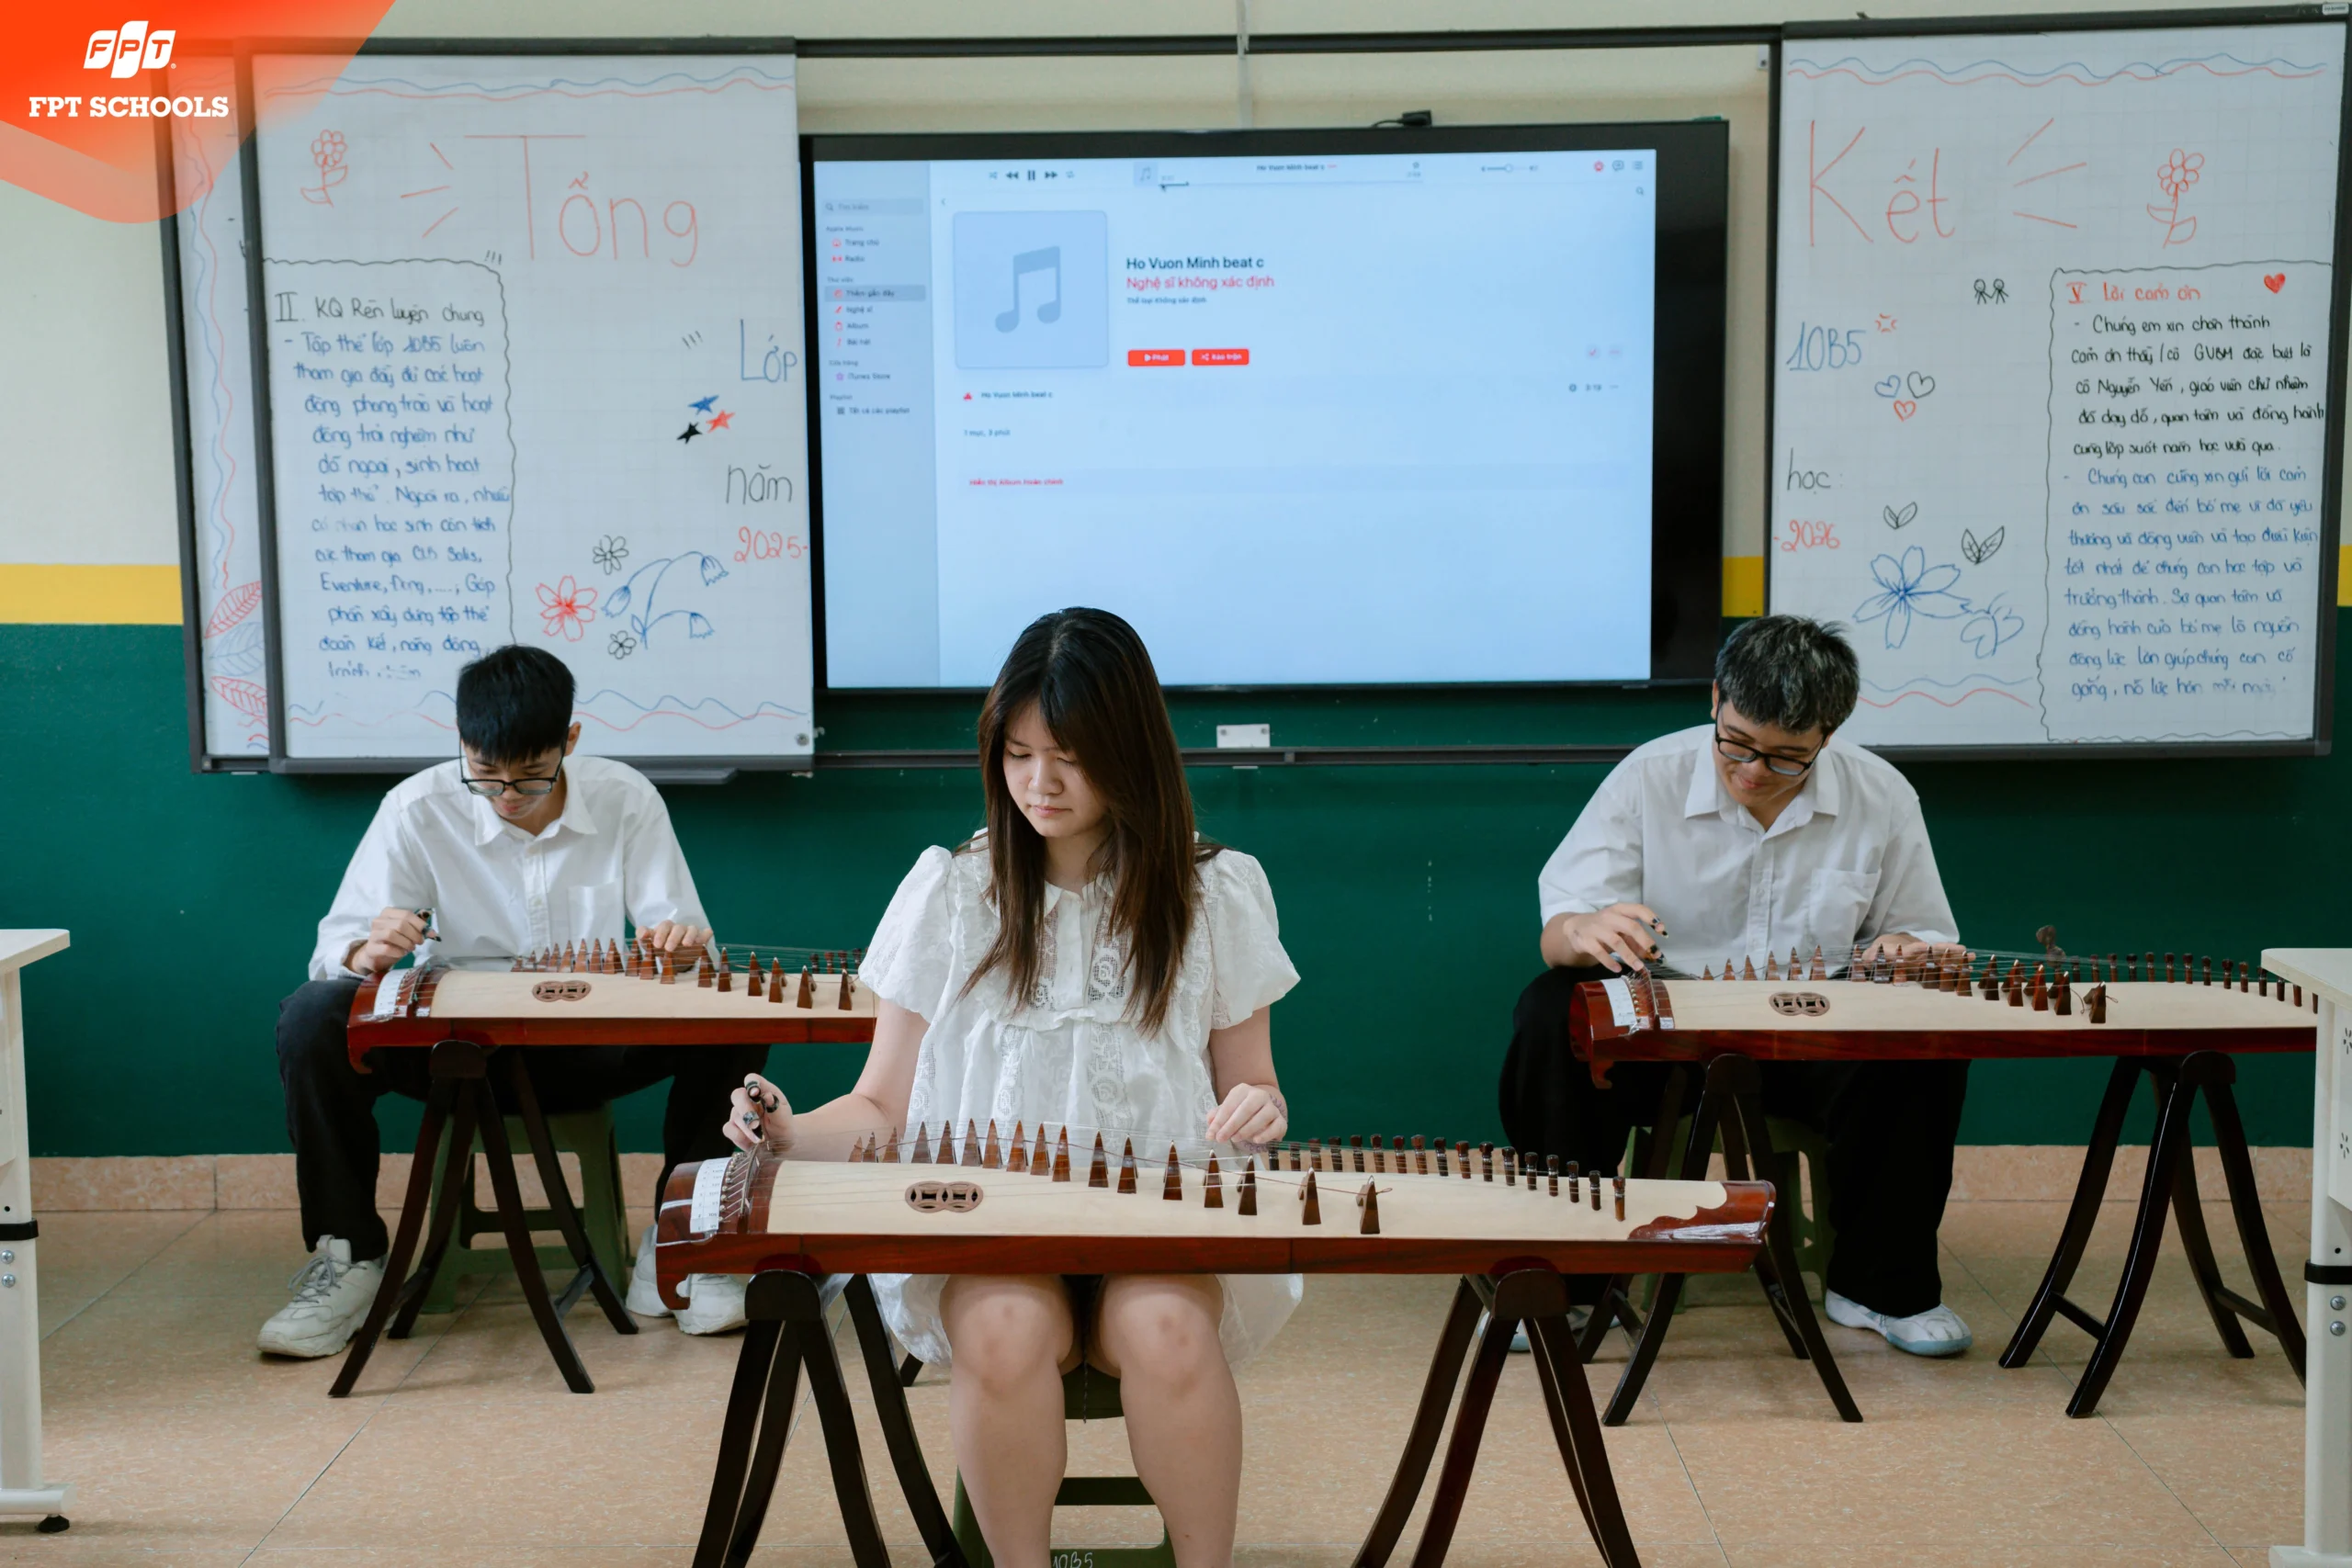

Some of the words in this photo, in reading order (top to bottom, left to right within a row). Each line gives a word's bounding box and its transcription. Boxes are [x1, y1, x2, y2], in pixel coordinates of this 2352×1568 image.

[464, 135, 697, 267] Tổng
[1810, 119, 1955, 247] Kết
[1126, 258, 1146, 269] Ho
[1148, 258, 1183, 269] Vuon
[1187, 257, 1219, 268] Minh
[1223, 257, 1252, 268] beat
[1126, 277, 1160, 291] Nghệ
[1165, 277, 1175, 288] sĩ
[1178, 276, 1217, 290] không
[1221, 277, 1242, 288] xác
[1246, 276, 1274, 288] định
[1786, 322, 1866, 371] 10B5
[2143, 321, 2161, 332] em
[740, 318, 798, 382] Lớp
[726, 464, 793, 505] năm
[1053, 1551, 1092, 1568] 10B5
